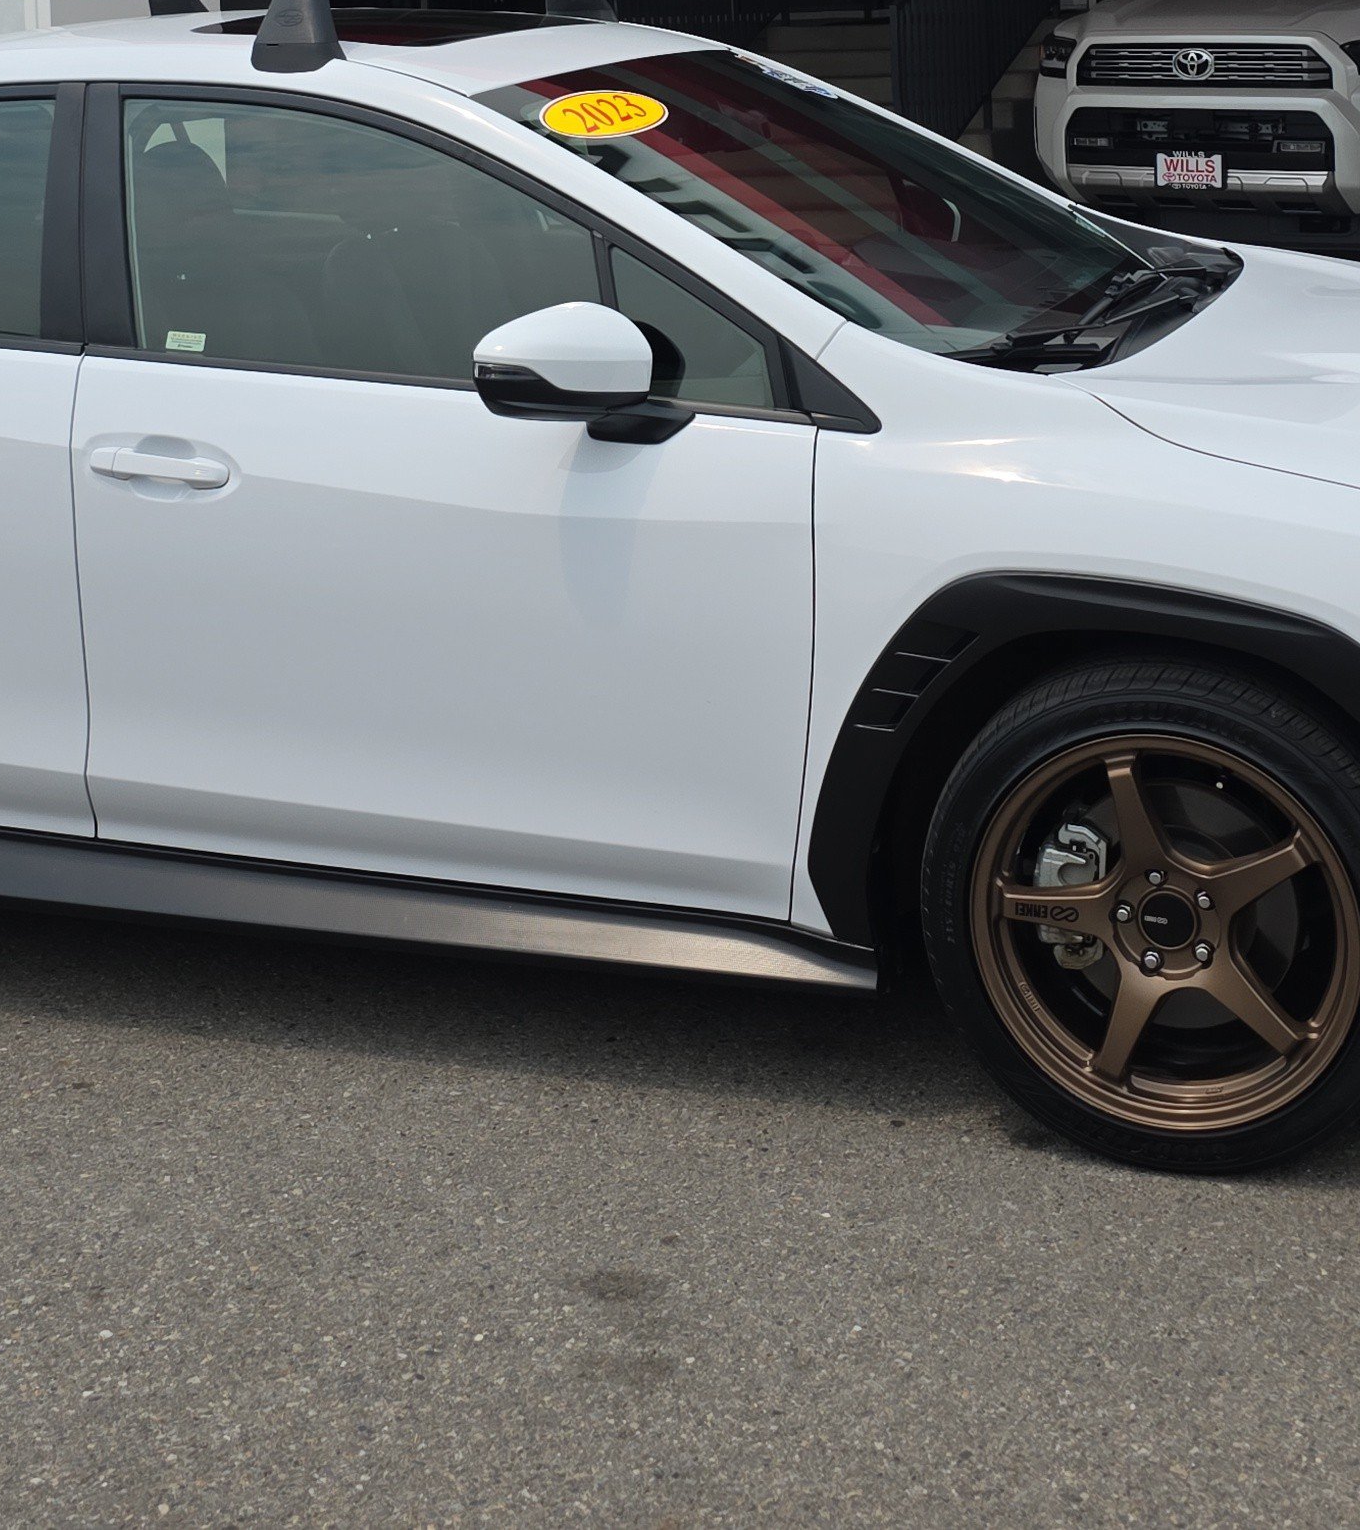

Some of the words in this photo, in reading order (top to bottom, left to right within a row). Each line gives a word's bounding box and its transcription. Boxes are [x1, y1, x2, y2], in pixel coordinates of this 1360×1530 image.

[562, 94, 648, 134] 2023
[1172, 150, 1205, 158] WILLS
[1164, 158, 1216, 174] WILLS
[1176, 173, 1218, 183] TOYOTA
[1014, 902, 1048, 919] ENKEI
